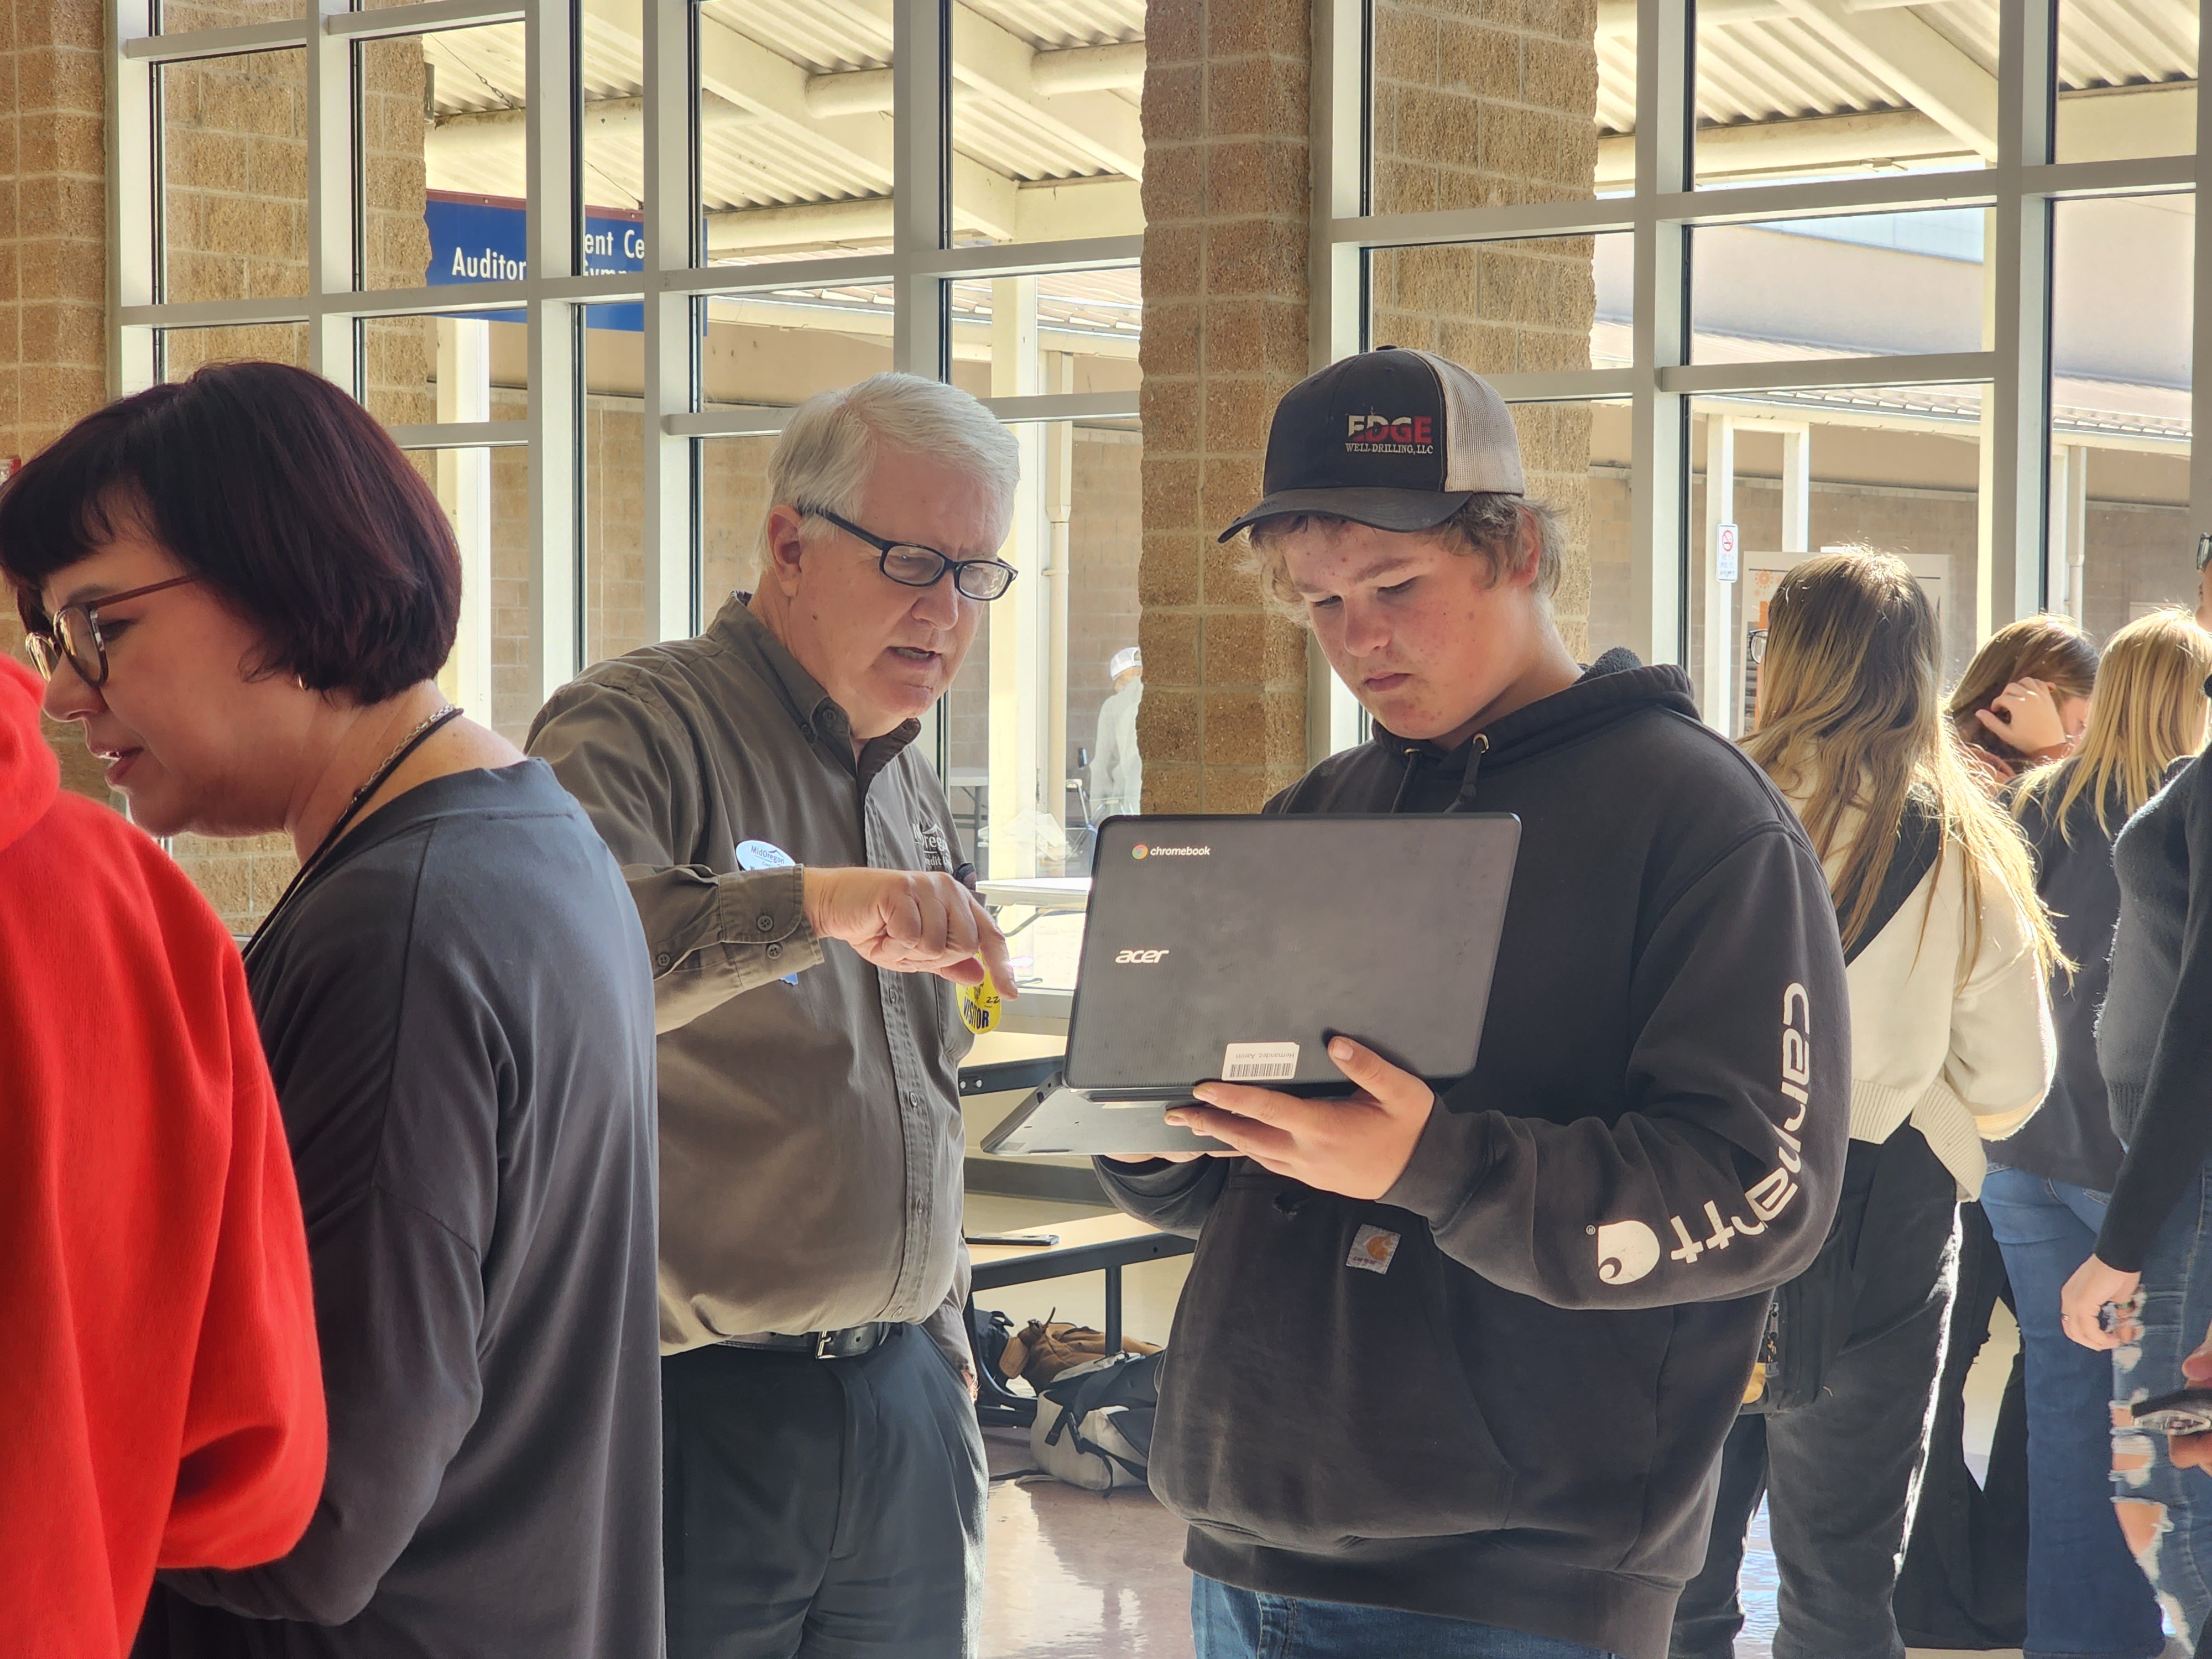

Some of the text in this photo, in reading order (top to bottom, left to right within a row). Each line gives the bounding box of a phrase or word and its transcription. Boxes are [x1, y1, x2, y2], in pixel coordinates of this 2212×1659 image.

[1348, 415, 1432, 444] EDGE
[1345, 443, 1371, 452] WELL
[751, 845, 784, 864] MidOregon
[1150, 846, 1211, 855] chromebook
[1115, 950, 1170, 963] acer
[963, 996, 989, 1030] VISITOR
